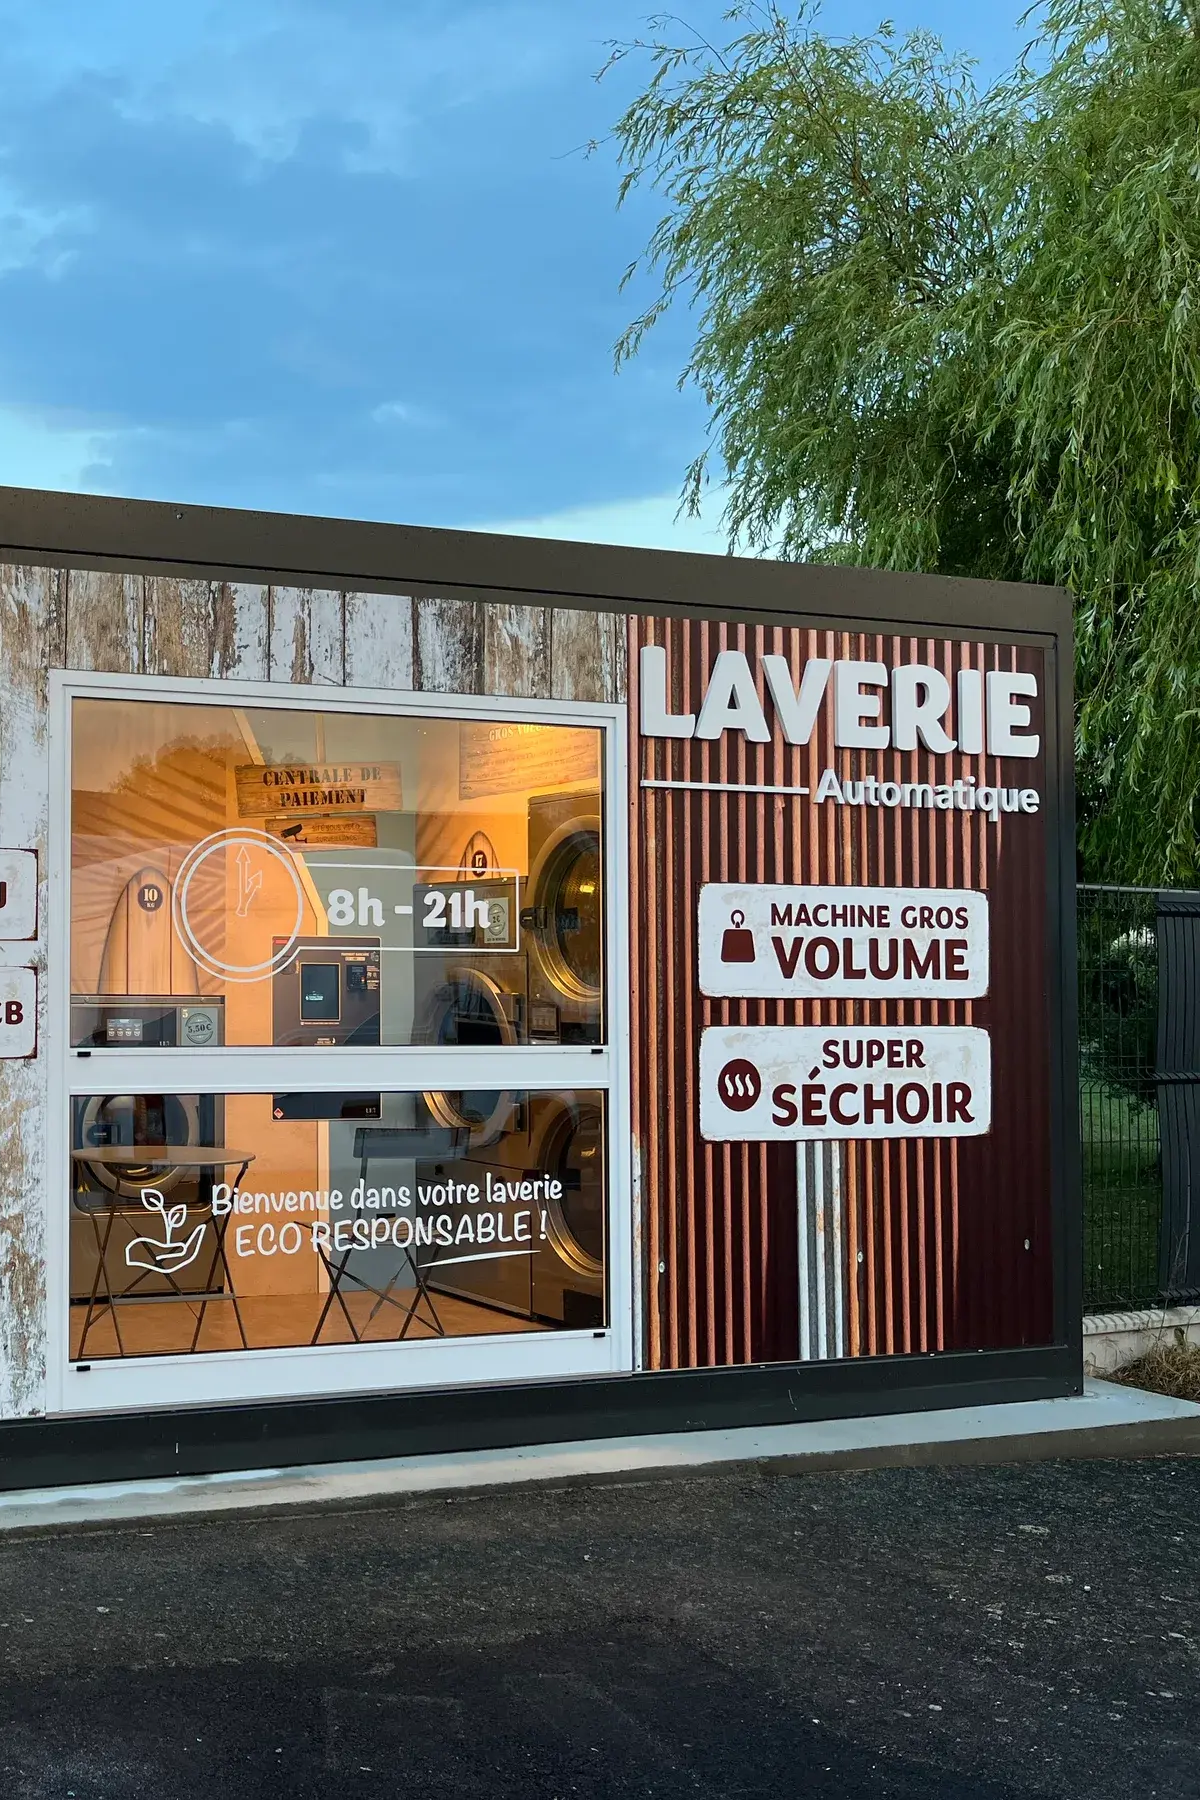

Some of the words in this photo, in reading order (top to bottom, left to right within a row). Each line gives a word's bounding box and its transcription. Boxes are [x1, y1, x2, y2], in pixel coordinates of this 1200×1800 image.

[639, 645, 1041, 759] LAVERIE
[488, 726, 514, 742] GROS
[262, 767, 352, 786] CENTRALE
[360, 766, 382, 781] DE
[280, 789, 367, 807] PAIEMENT
[813, 767, 1040, 822] Automatique
[143, 888, 158, 901] 10
[327, 887, 385, 927] 8h
[394, 905, 413, 915] -
[422, 889, 492, 929] 21h
[770, 903, 890, 928] MACHINE
[900, 905, 969, 929] GROS
[771, 936, 969, 981] VOLUME
[182, 1009, 189, 1018] 5
[822, 1038, 926, 1069] SUPER
[772, 1065, 975, 1127] SÉCHOIR
[211, 1183, 344, 1216] Bienvenue
[350, 1178, 411, 1210] dans
[417, 1179, 480, 1206] votre
[485, 1172, 563, 1204] laverie
[235, 1222, 301, 1258] ECO
[310, 1210, 532, 1253] RESPONSABLE
